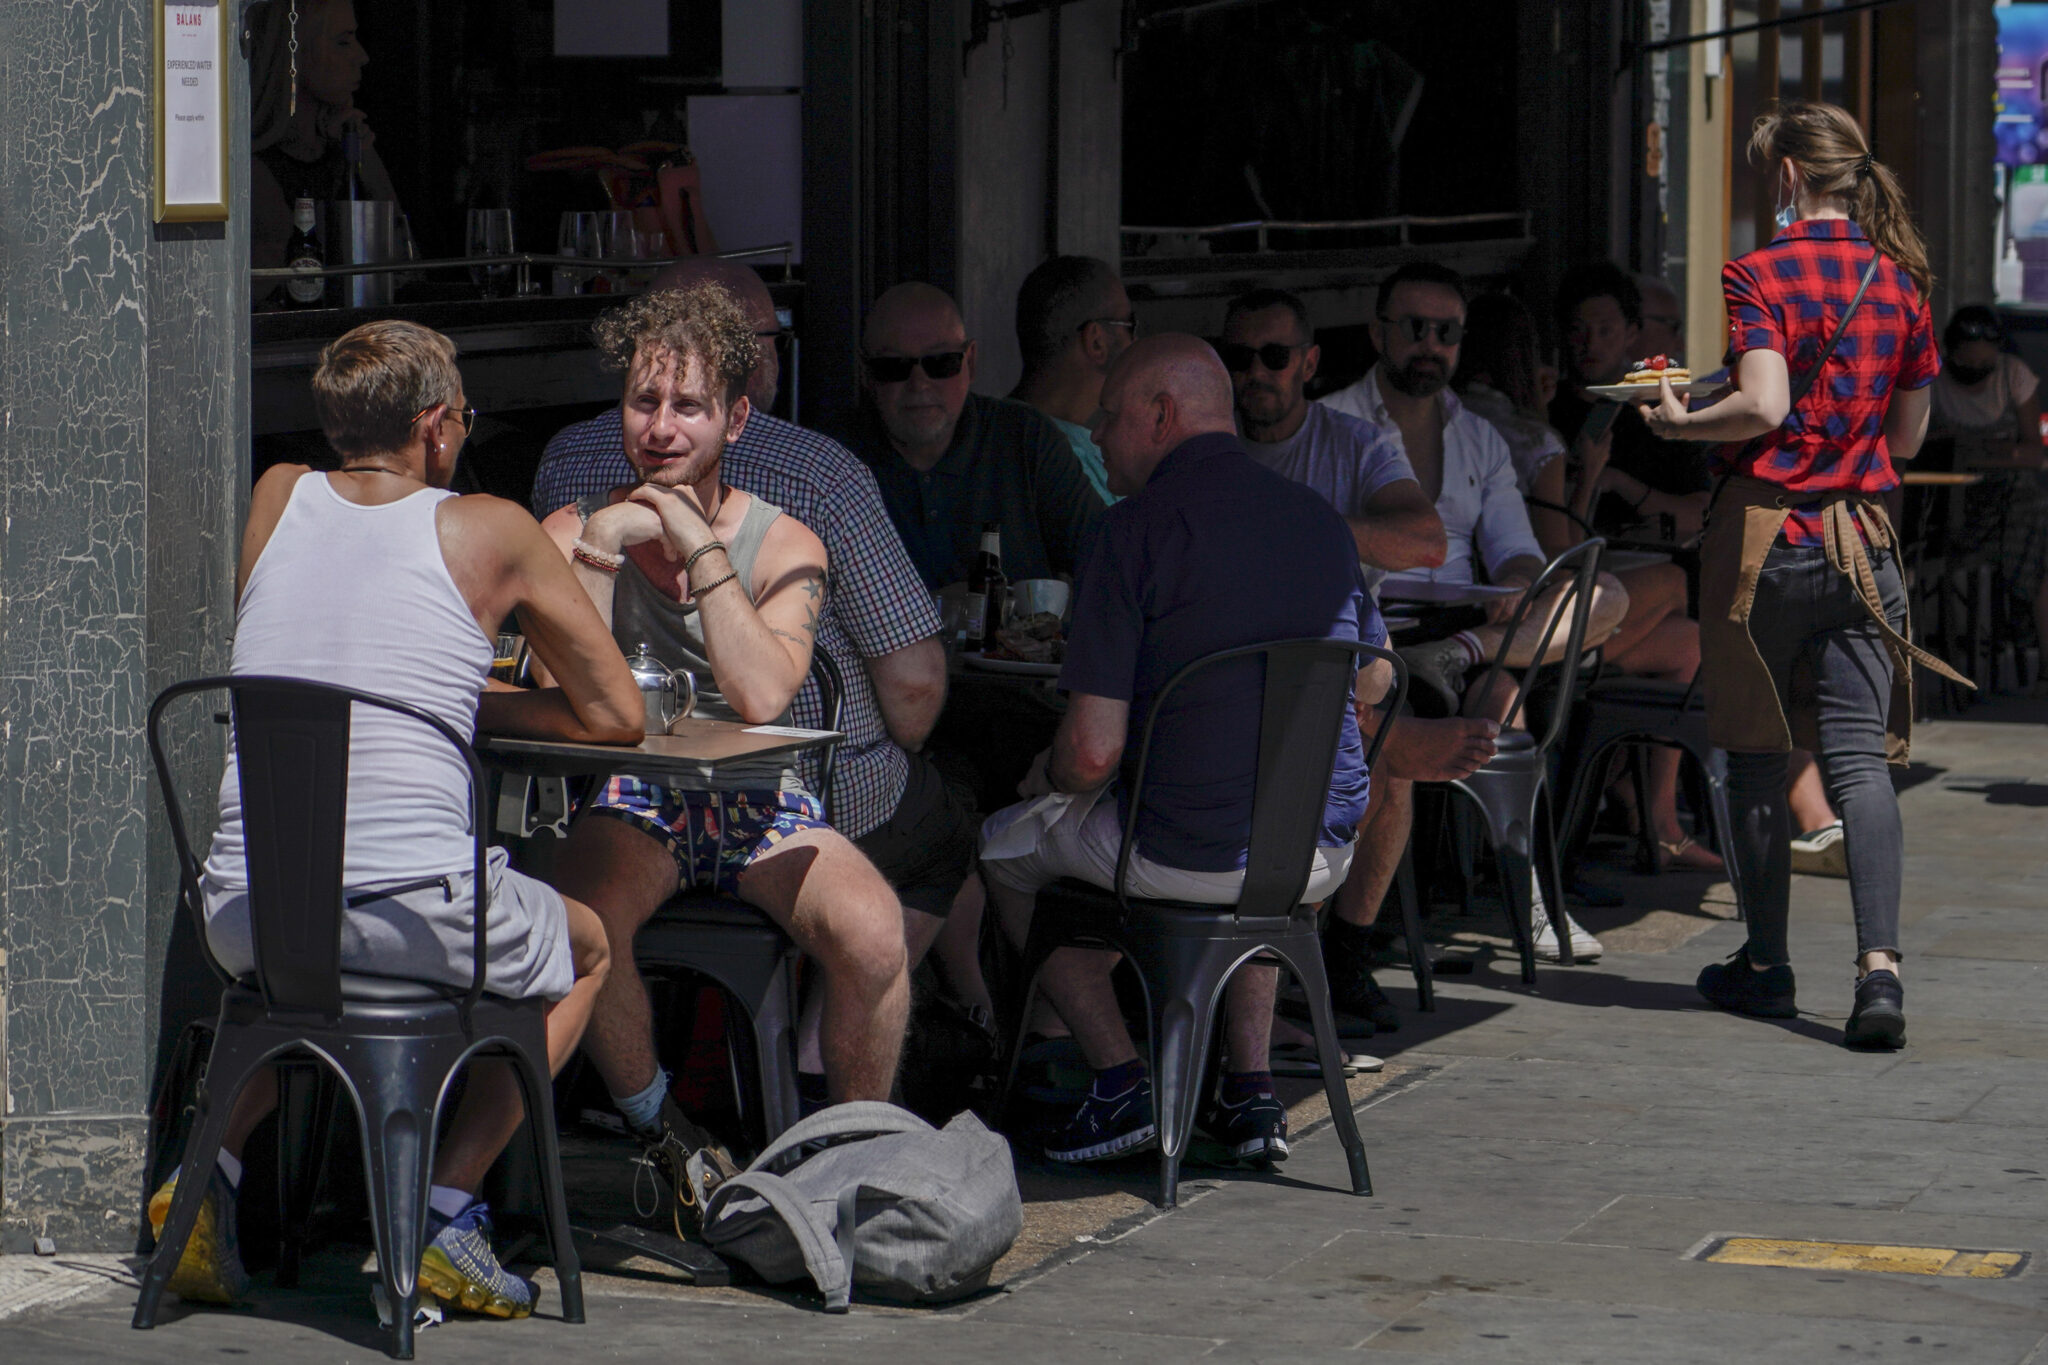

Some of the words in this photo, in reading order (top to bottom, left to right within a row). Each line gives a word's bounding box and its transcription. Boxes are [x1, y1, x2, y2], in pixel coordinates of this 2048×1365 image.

[176, 13, 202, 26] BALANS
[167, 60, 195, 70] EXPERIENCED
[196, 60, 212, 70] WAITER
[181, 76, 199, 87] NEEDED
